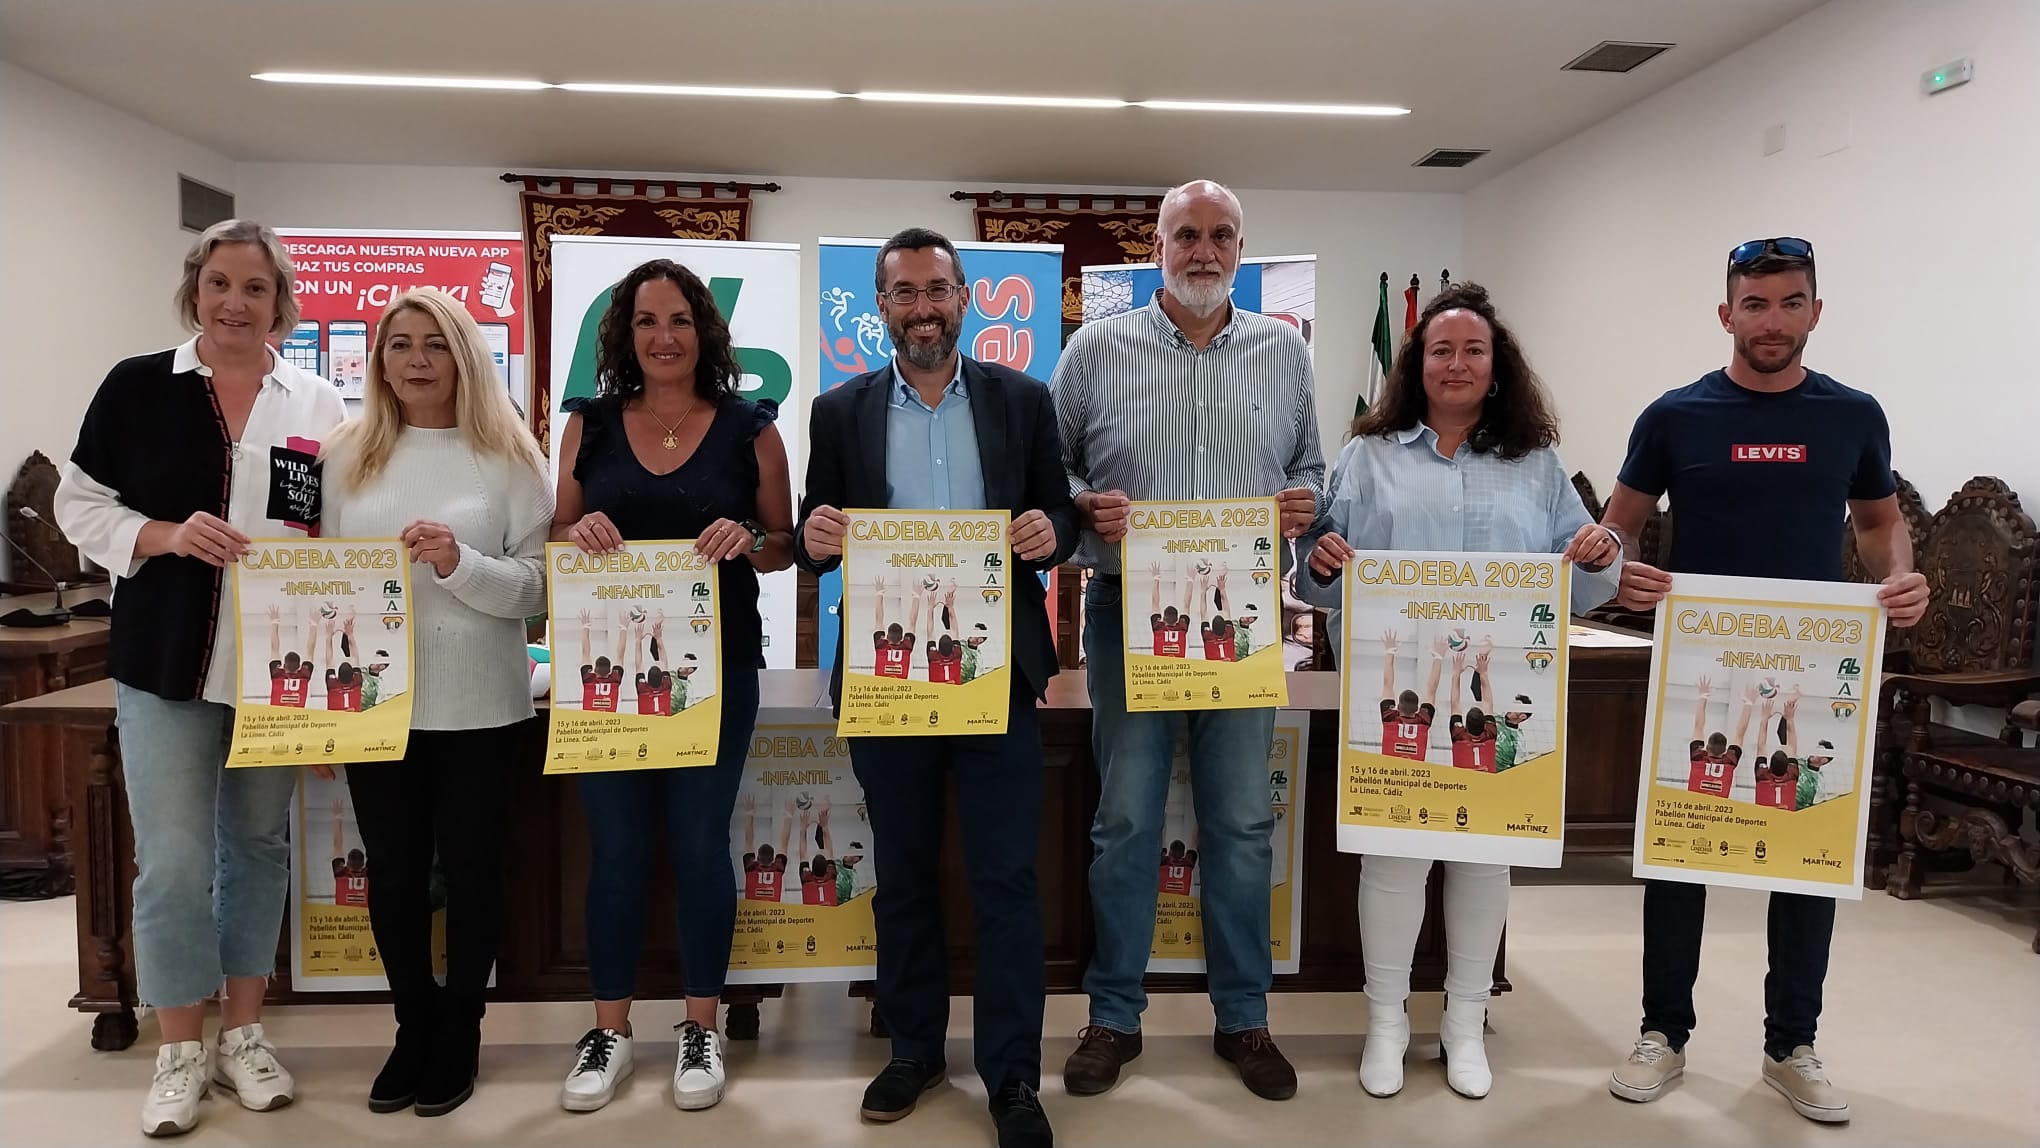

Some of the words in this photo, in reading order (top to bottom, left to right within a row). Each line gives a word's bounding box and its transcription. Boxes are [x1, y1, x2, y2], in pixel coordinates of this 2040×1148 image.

[360, 246, 425, 257] NUESTRA
[429, 247, 477, 257] NUEVA
[481, 248, 509, 258] APP
[323, 262, 350, 272] TUS
[354, 262, 424, 274] COMPRAS
[325, 281, 352, 294] UN
[1738, 448, 1800, 459] LEVI'S
[274, 458, 308, 473] WILD
[289, 471, 319, 487] LIVES
[288, 490, 314, 505] SOUL
[1130, 509, 1216, 529] CADEBA
[1221, 508, 1270, 527] 2023
[852, 520, 944, 541] CADEBA
[949, 521, 1000, 541] 2023
[241, 549, 340, 569] CADEBA
[344, 549, 398, 569] 2023
[556, 552, 650, 574] CADEBA
[655, 552, 706, 571] 2023
[1357, 559, 1478, 586] CADEBA
[1485, 562, 1553, 588] 2023
[1677, 609, 1791, 640] CADEBA
[1797, 616, 1862, 644] 2023
[1164, 631, 1178, 642] 10
[887, 650, 902, 662] 10
[1219, 644, 1225, 658] 1
[944, 666, 949, 680] 1
[1193, 670, 1217, 678] Deportes
[283, 679, 300, 691] 10
[595, 683, 611, 695] 10
[343, 693, 350, 708] 1
[875, 693, 904, 701] Municipal
[914, 693, 939, 701] Deportes
[653, 697, 660, 712] 1
[583, 727, 612, 735] Municipal
[622, 726, 648, 734] Deportes
[1398, 724, 1418, 739] 10
[1473, 747, 1481, 766] 1
[1350, 766, 1360, 774] 15
[1368, 767, 1377, 775] 16
[1379, 767, 1388, 775] de
[1391, 768, 1410, 777] abril.
[1411, 769, 1431, 778] 2023
[1704, 763, 1724, 777] 10
[1350, 776, 1382, 785] Pabellón
[1384, 778, 1420, 788] Municipal
[1423, 780, 1432, 788] de
[1433, 781, 1467, 792] Deportes
[1350, 786, 1358, 794] La
[1383, 787, 1403, 797] Cádiz
[1775, 786, 1782, 804] 1
[1656, 799, 1666, 808] 15
[1673, 801, 1683, 809] 16
[1684, 802, 1693, 810] de
[1694, 803, 1713, 812] abril.
[1714, 805, 1733, 814] 2023
[1655, 809, 1686, 819] Pabellón
[1688, 812, 1723, 823] Municipal
[1725, 815, 1734, 823] de
[1735, 817, 1767, 827] Deportes
[1655, 818, 1664, 826] La
[1686, 821, 1705, 830] Cádiz
[1507, 823, 1548, 834] MARTINEZ
[1802, 857, 1842, 868] MARTINEZ
[758, 872, 773, 884] 10
[1157, 910, 1185, 918] Municipal
[788, 917, 814, 925] Deportes
[310, 924, 337, 932] Pabellón
[339, 924, 369, 933] Municipal
